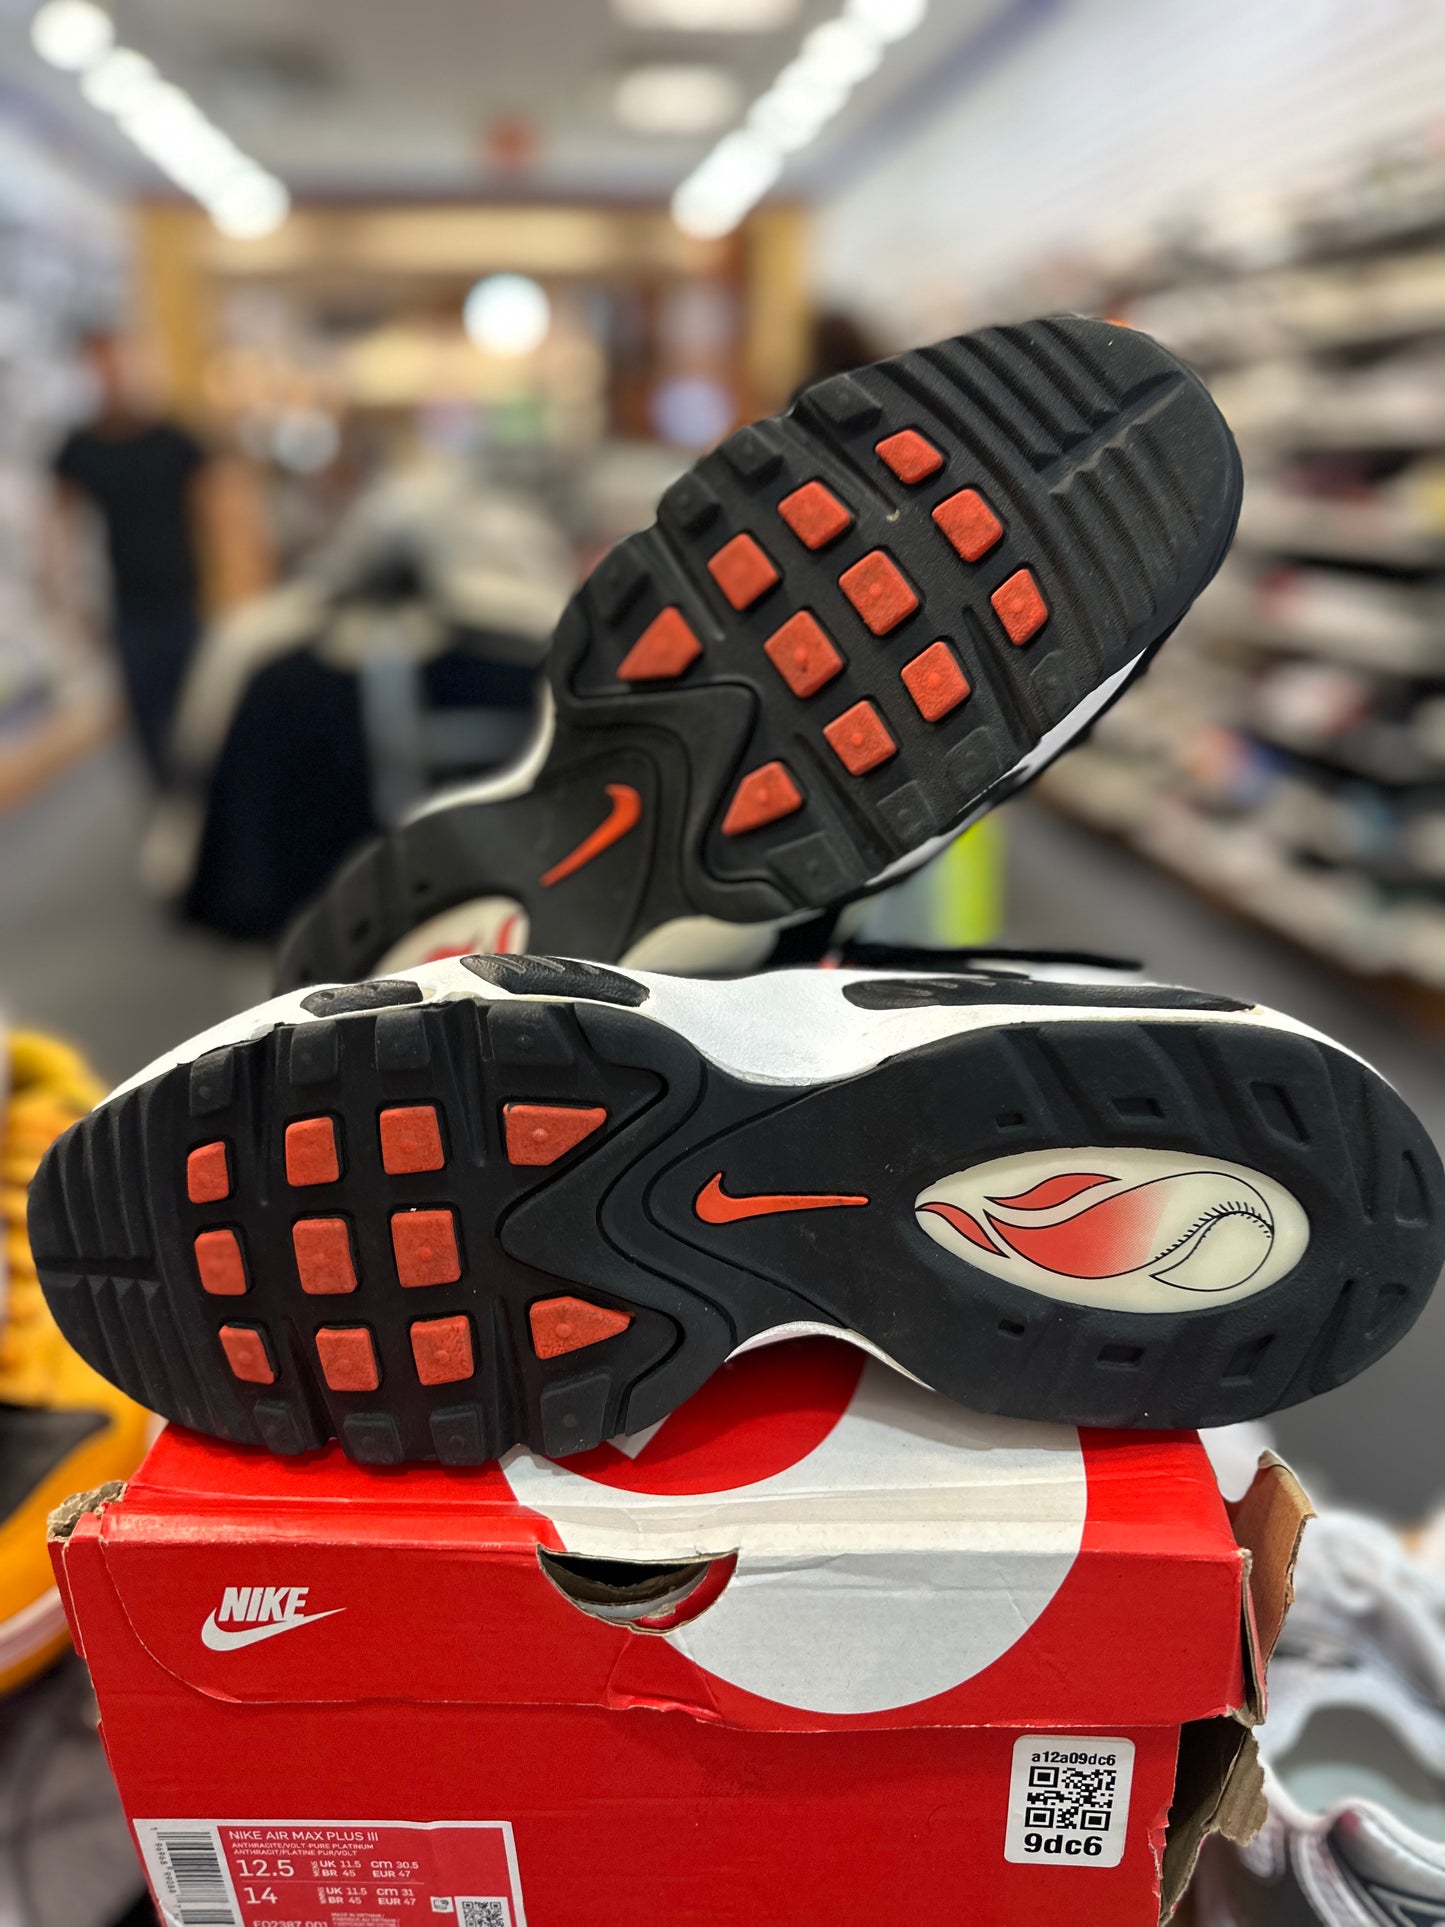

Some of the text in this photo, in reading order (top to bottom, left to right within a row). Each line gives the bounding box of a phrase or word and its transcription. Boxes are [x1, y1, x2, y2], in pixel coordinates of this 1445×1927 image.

[218, 1587, 309, 1622] NIKE
[1032, 1751, 1117, 1766] a12a09dc6
[229, 1830, 379, 1841] NIKE AIR MAX PLUS III
[1024, 1833, 1103, 1856] 9dc6
[236, 1859, 295, 1877] 12.5
[320, 1860, 336, 1868] UK
[371, 1861, 393, 1869] cm
[322, 1869, 338, 1877] BR
[372, 1870, 396, 1878] EUR
[244, 1886, 278, 1904] 14
[326, 1887, 368, 1895] UK 11.5
[376, 1888, 414, 1897] cm 31
[328, 1896, 344, 1904] BR
[403, 1898, 417, 1906] 47
